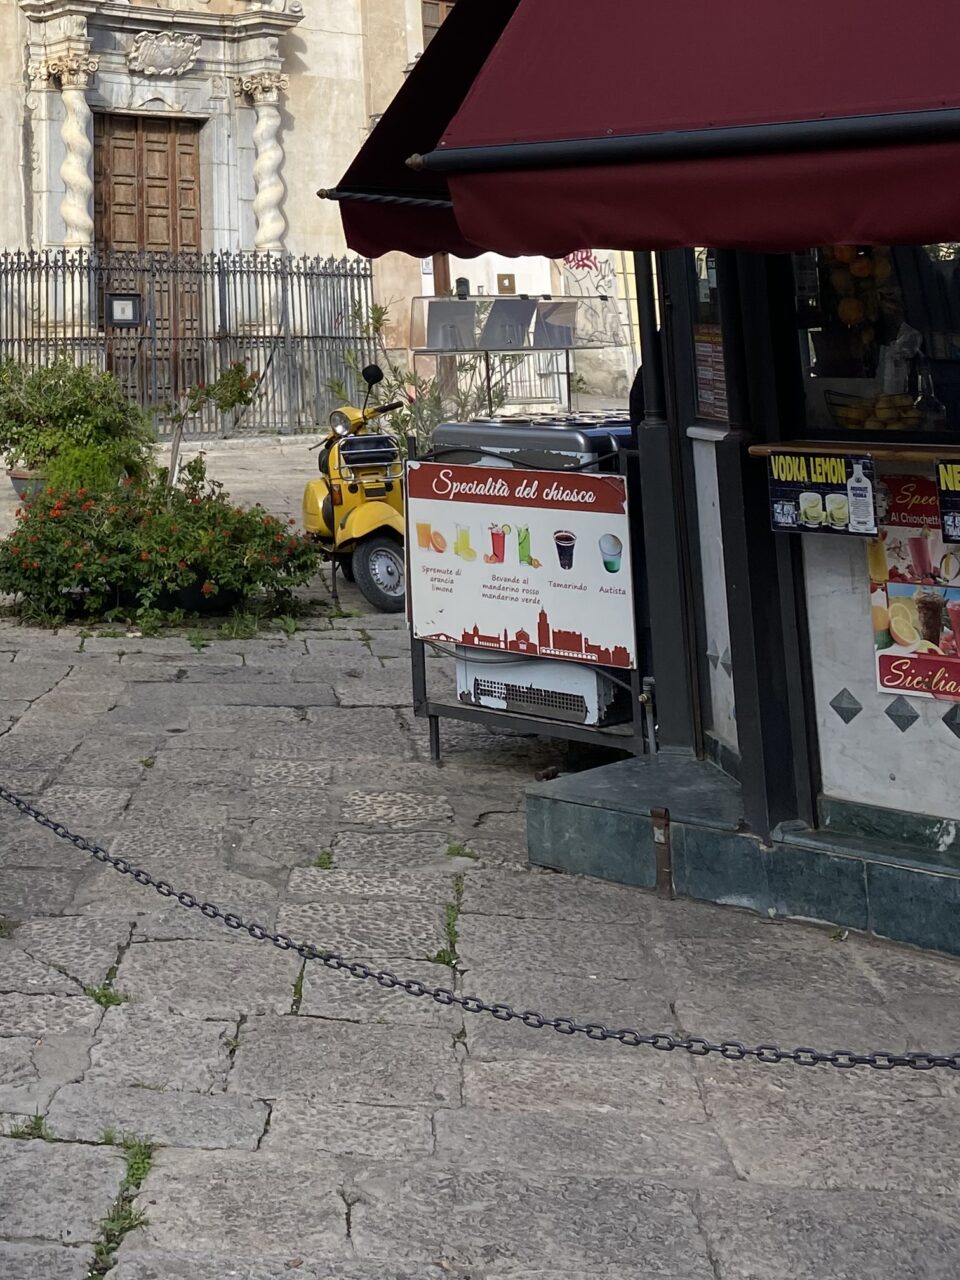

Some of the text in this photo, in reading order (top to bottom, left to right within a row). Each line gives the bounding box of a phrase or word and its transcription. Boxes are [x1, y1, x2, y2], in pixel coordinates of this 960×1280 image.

[771, 455, 847, 484] VODKA LEMON
[432, 469, 597, 503] Specialità del chiosco
[895, 483, 939, 509] Spec
[900, 512, 940, 525] Chioschett
[421, 564, 462, 576] Spremute di
[430, 576, 454, 585] arancia
[491, 574, 529, 585] Bevande al
[548, 580, 588, 591] Tamarindo
[431, 583, 454, 593] limone
[482, 584, 540, 596] mandarino rosso
[599, 586, 627, 595] Autista
[482, 593, 541, 605] mandarino verde
